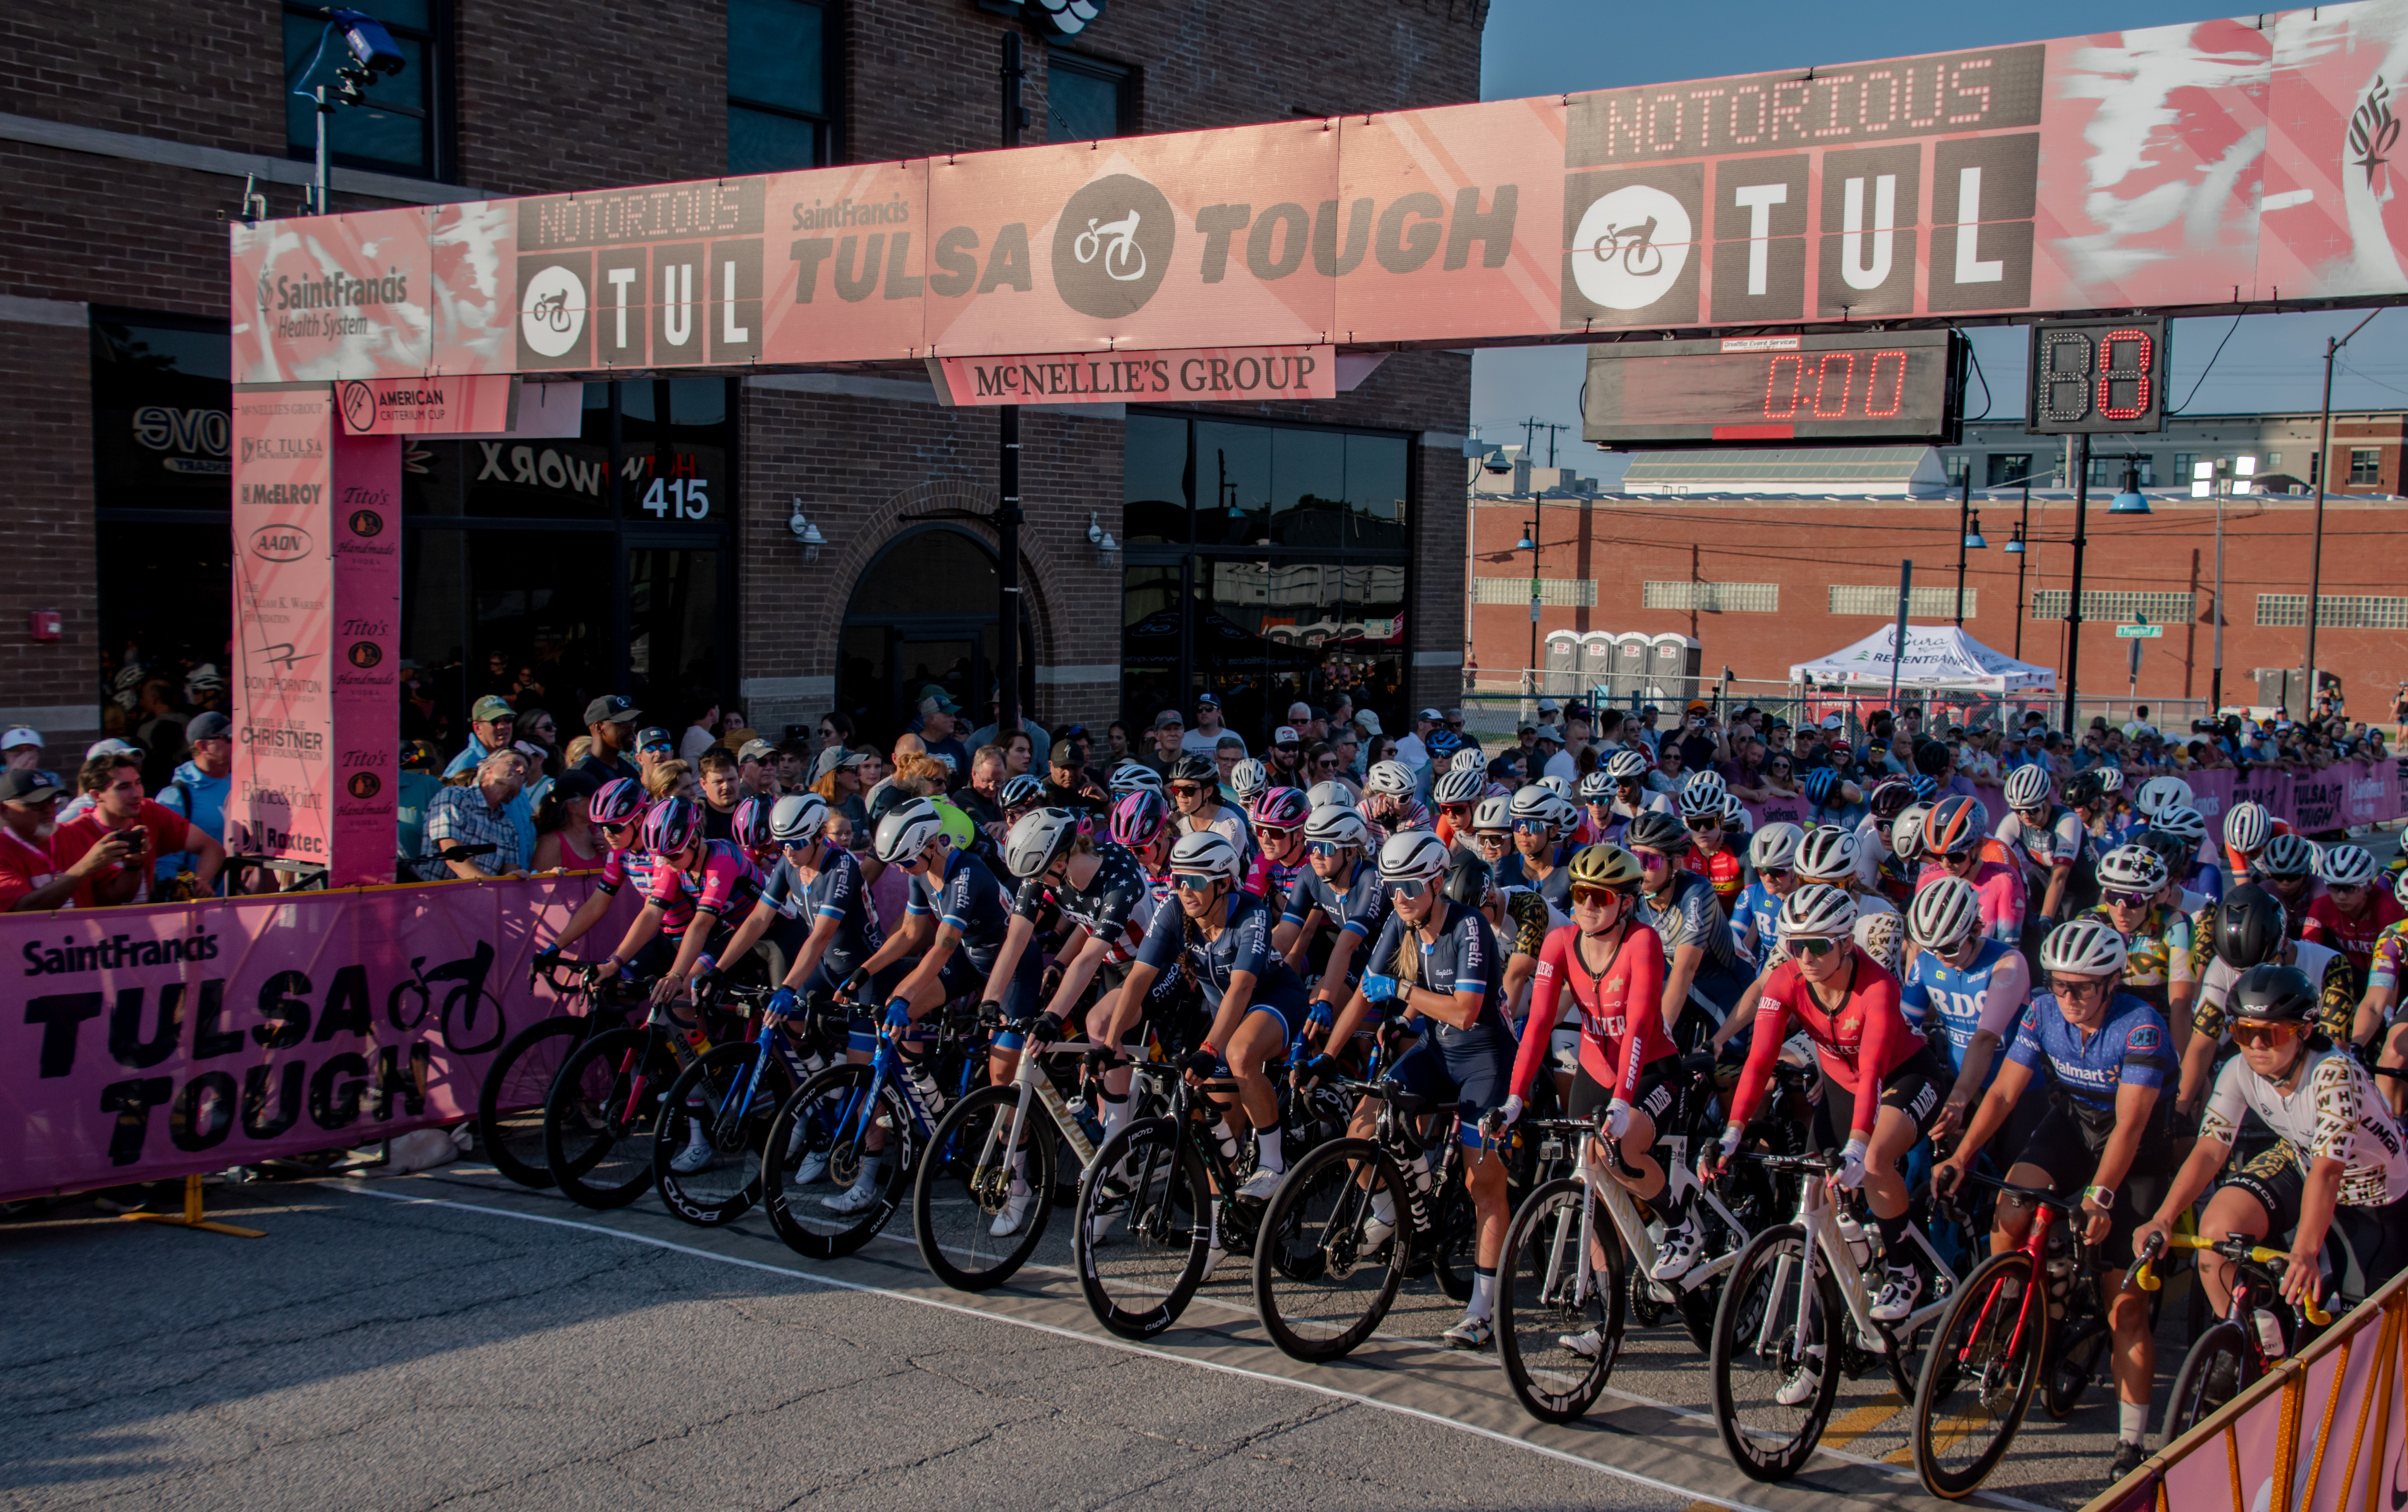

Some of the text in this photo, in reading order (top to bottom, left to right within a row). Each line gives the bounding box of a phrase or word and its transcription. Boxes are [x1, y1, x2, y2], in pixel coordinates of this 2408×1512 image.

[1609, 59, 1992, 155] NOTORIOUS
[539, 185, 740, 244] NOTORIOUS
[789, 184, 1519, 305] TULSA TOUGH
[278, 313, 368, 342] Health System
[1180, 356, 1315, 392] GROUP
[1764, 351, 1907, 418] 0:00
[291, 403, 323, 414] GROUP
[379, 390, 445, 407] AMERICAN
[380, 409, 445, 421] CRITERIUM CUP
[257, 438, 322, 453] FC TULSA
[252, 484, 322, 504] McELROY
[343, 487, 389, 506] Tito's
[642, 477, 710, 520] 415
[257, 535, 303, 551] AAON
[336, 540, 395, 555] Handmade
[343, 618, 388, 636] Tito's
[244, 676, 321, 693] DON THORNTON
[336, 671, 394, 685] Handmade
[241, 727, 323, 751] CHRISTNER
[342, 749, 388, 767] Tito's
[2294, 783, 2327, 806] TULSA
[336, 802, 393, 816] Handmade
[2296, 807, 2335, 830] TOUGH
[267, 828, 322, 853] Roxtec
[917, 827, 926, 848] ABUS
[1043, 832, 1056, 854] LAZER
[1347, 825, 1360, 838] ABUS
[1220, 856, 1233, 869] ABUS
[1433, 851, 1443, 868] ABUS
[1691, 862, 1702, 870] UTC
[1322, 904, 1340, 916] NCL
[1152, 962, 1181, 998] CYNISCA
[1435, 968, 1454, 977] Safetti
[23, 965, 373, 1079] TULSA
[1949, 1030, 1965, 1044] FAT
[750, 1054, 767, 1094] TIME
[1625, 1036, 1642, 1091] SRAM
[100, 1041, 431, 1167] TOUGH
[795, 1088, 816, 1114] BOYD
[865, 1077, 882, 1117] TIME
[1643, 1084, 1672, 1118] BLAZERS
[1910, 1081, 1937, 1122] BLAZERS
[881, 1085, 912, 1172] BOYD
[1038, 1076, 1096, 1160] VENTUM
[1131, 1127, 1154, 1141] BOYD
[664, 1175, 723, 1222] BOYD
[2225, 1177, 2276, 1211] JAKROO
[870, 1207, 890, 1234] BOYD
[1083, 1167, 1107, 1280] BOYD
[1703, 1257, 1736, 1276] CANYON
[1145, 1318, 1168, 1331] BOYD
